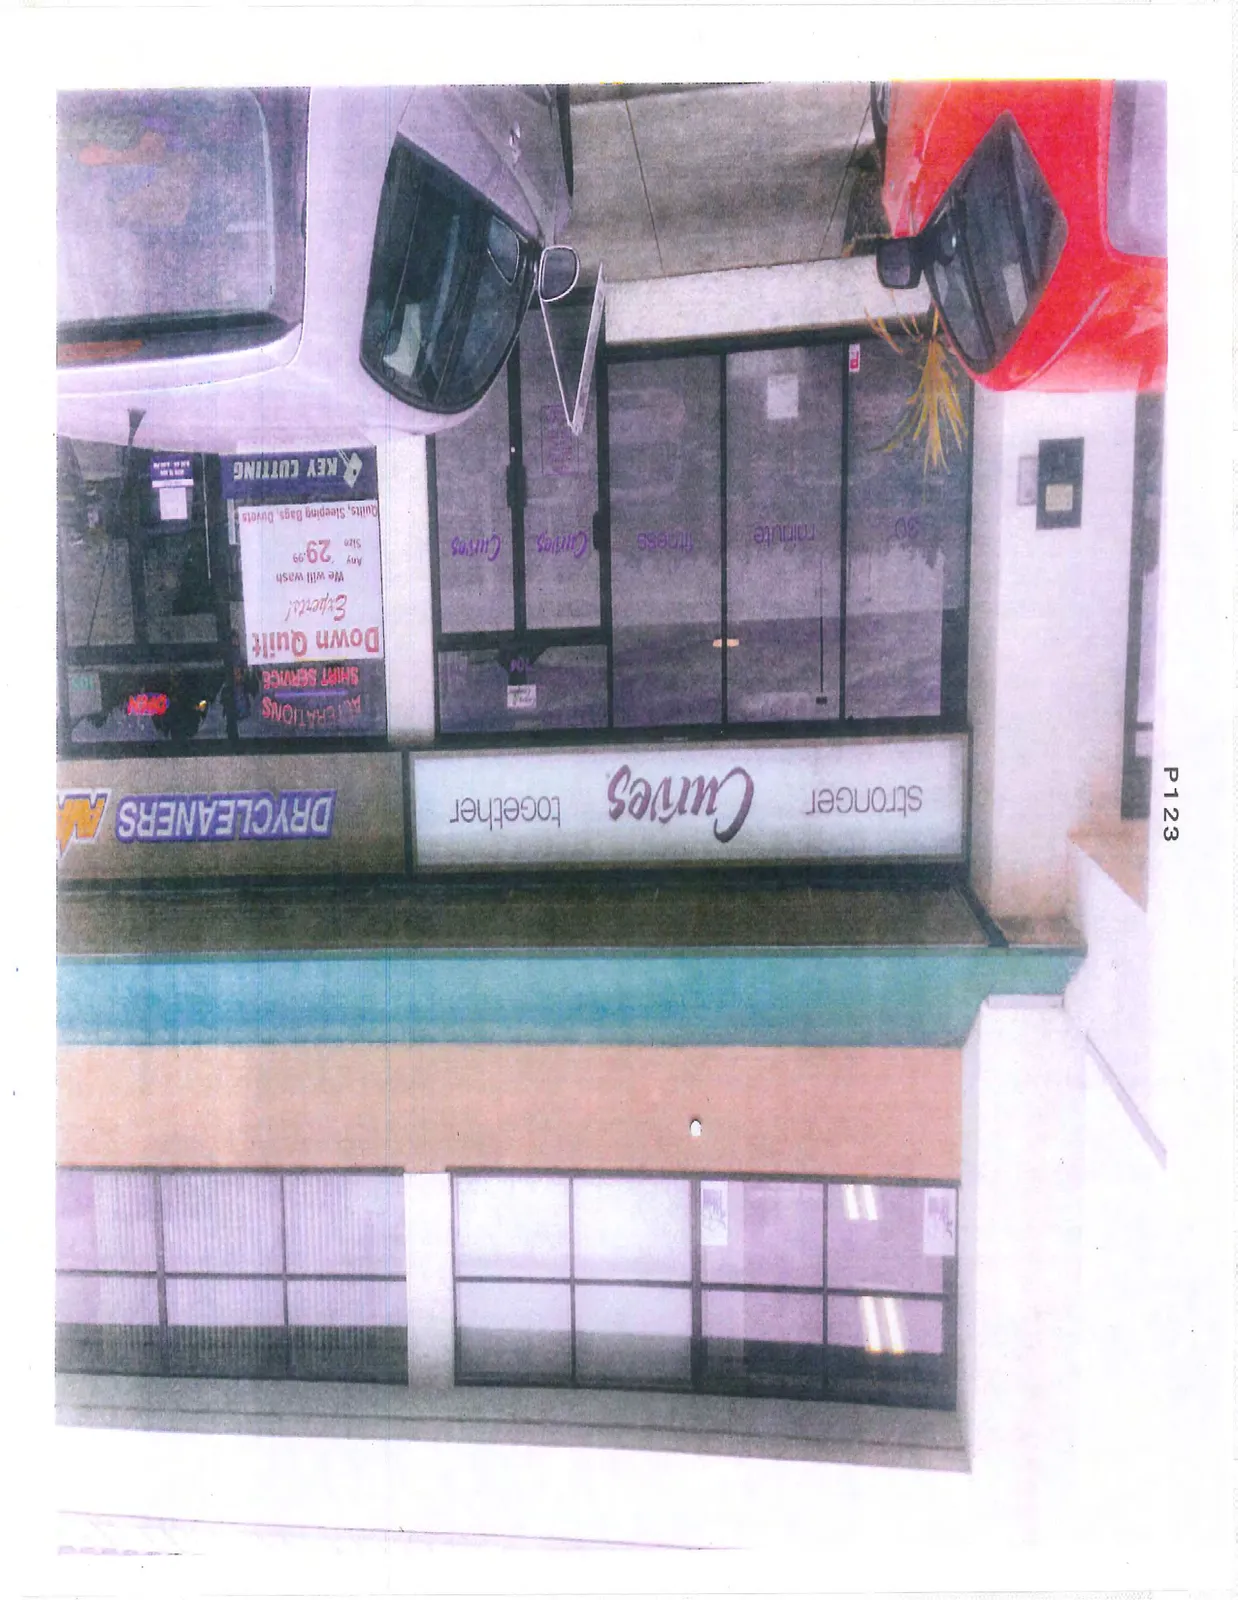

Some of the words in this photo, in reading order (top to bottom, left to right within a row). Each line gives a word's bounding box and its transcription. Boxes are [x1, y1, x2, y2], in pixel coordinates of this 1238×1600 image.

[233, 459, 300, 481] CUTTING
[306, 457, 338, 477] KEY
[305, 505, 346, 521] Sleeping
[348, 504, 378, 519] Quilts,
[343, 538, 362, 548] Size
[535, 530, 588, 560] Curves
[637, 530, 693, 551] fitness
[752, 523, 816, 547] minute
[450, 534, 501, 562] Curves
[346, 555, 362, 566] Any
[276, 572, 304, 584] wash
[306, 572, 325, 584] will
[327, 571, 344, 583] We
[285, 592, 347, 622] Experts!
[251, 629, 308, 659] Quilt
[315, 627, 379, 655] Down
[262, 668, 317, 689] SERVICE
[321, 666, 360, 687] SHIRT
[127, 693, 168, 716] OPEN
[261, 694, 361, 728] ALTERATIONS
[607, 764, 755, 844] Curves
[805, 784, 924, 817] stronger
[117, 796, 333, 839] DRYCLEANERS
[449, 793, 561, 831] together
